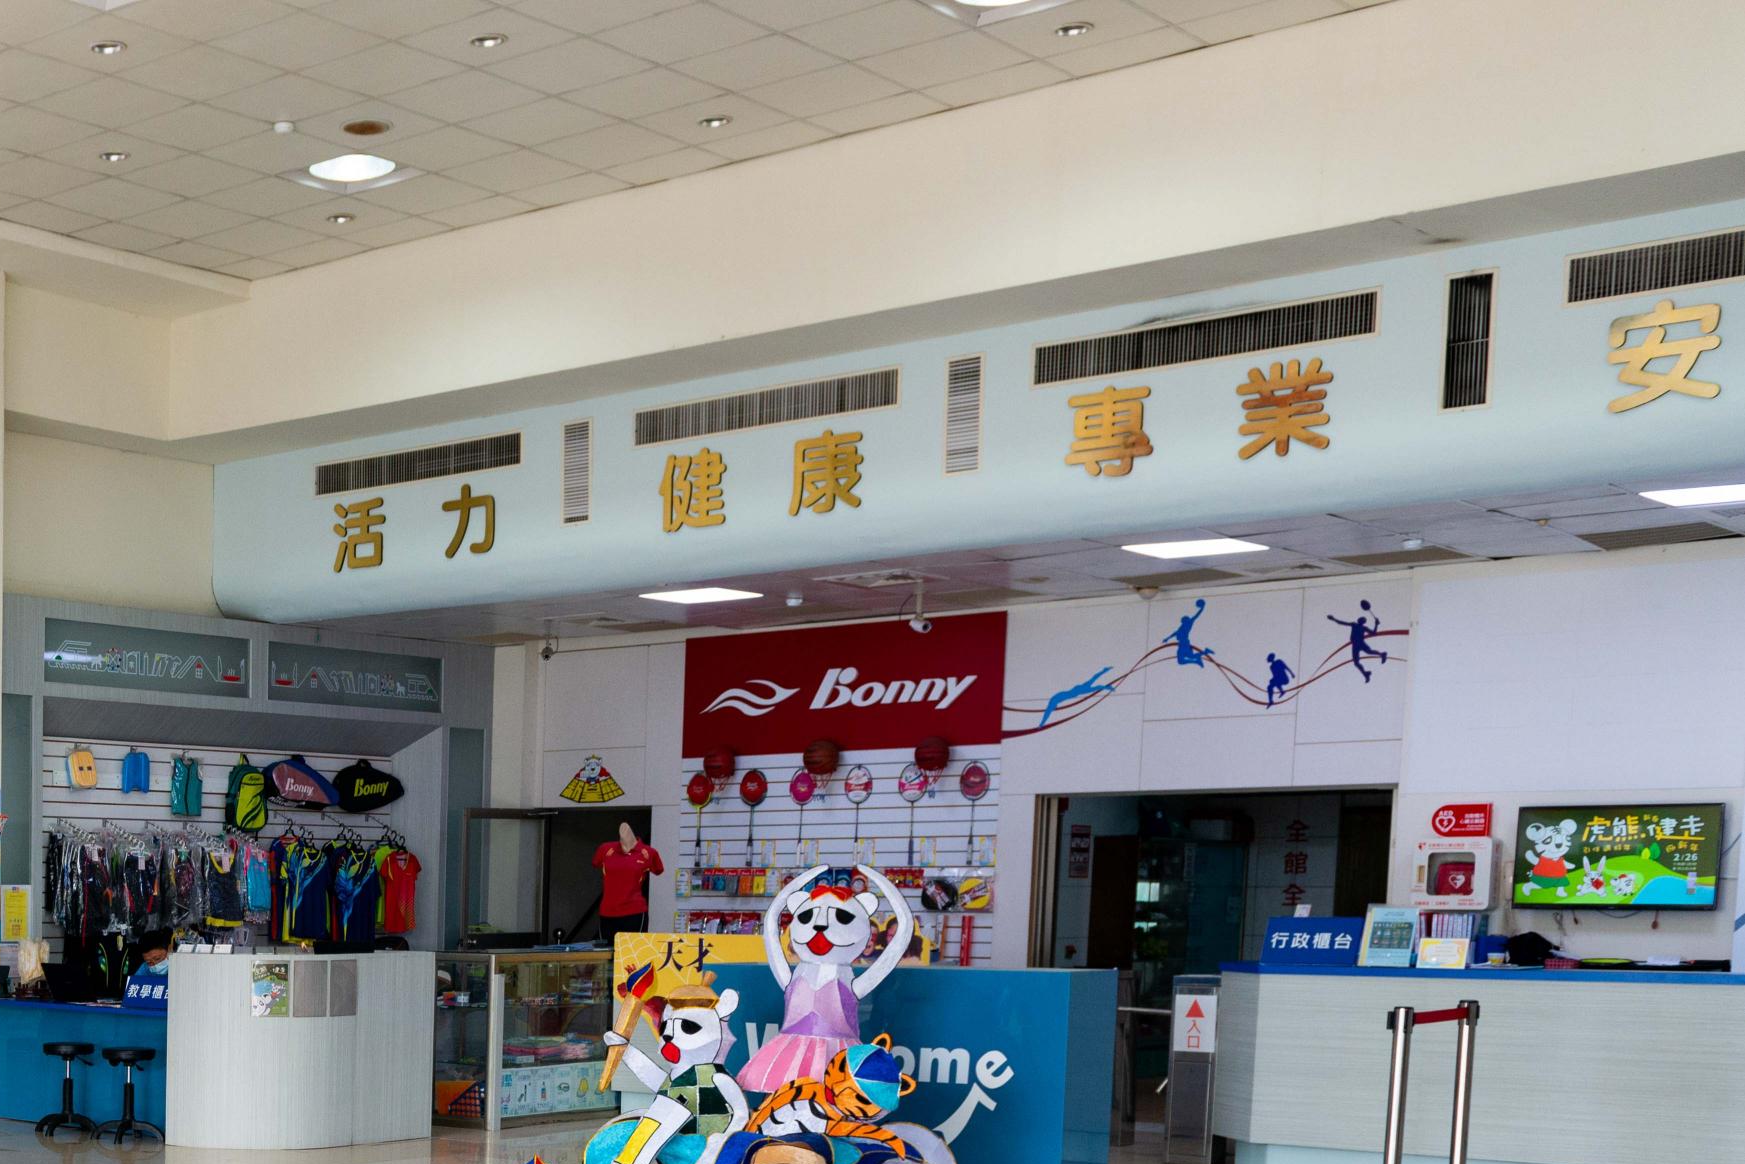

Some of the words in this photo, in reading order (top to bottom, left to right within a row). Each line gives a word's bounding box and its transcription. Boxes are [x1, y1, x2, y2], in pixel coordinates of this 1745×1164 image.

[333, 484, 496, 573] 活力
[659, 428, 864, 533] 健康
[1064, 357, 1325, 477] 專業
[1607, 300, 1722, 414] 安
[809, 667, 978, 709] Bonny
[285, 778, 314, 795] Bonny
[354, 778, 389, 797] Bonny
[1271, 931, 1353, 949] 行政櫃台
[656, 938, 714, 974] 天才
[1187, 1020, 1201, 1049] 入口
